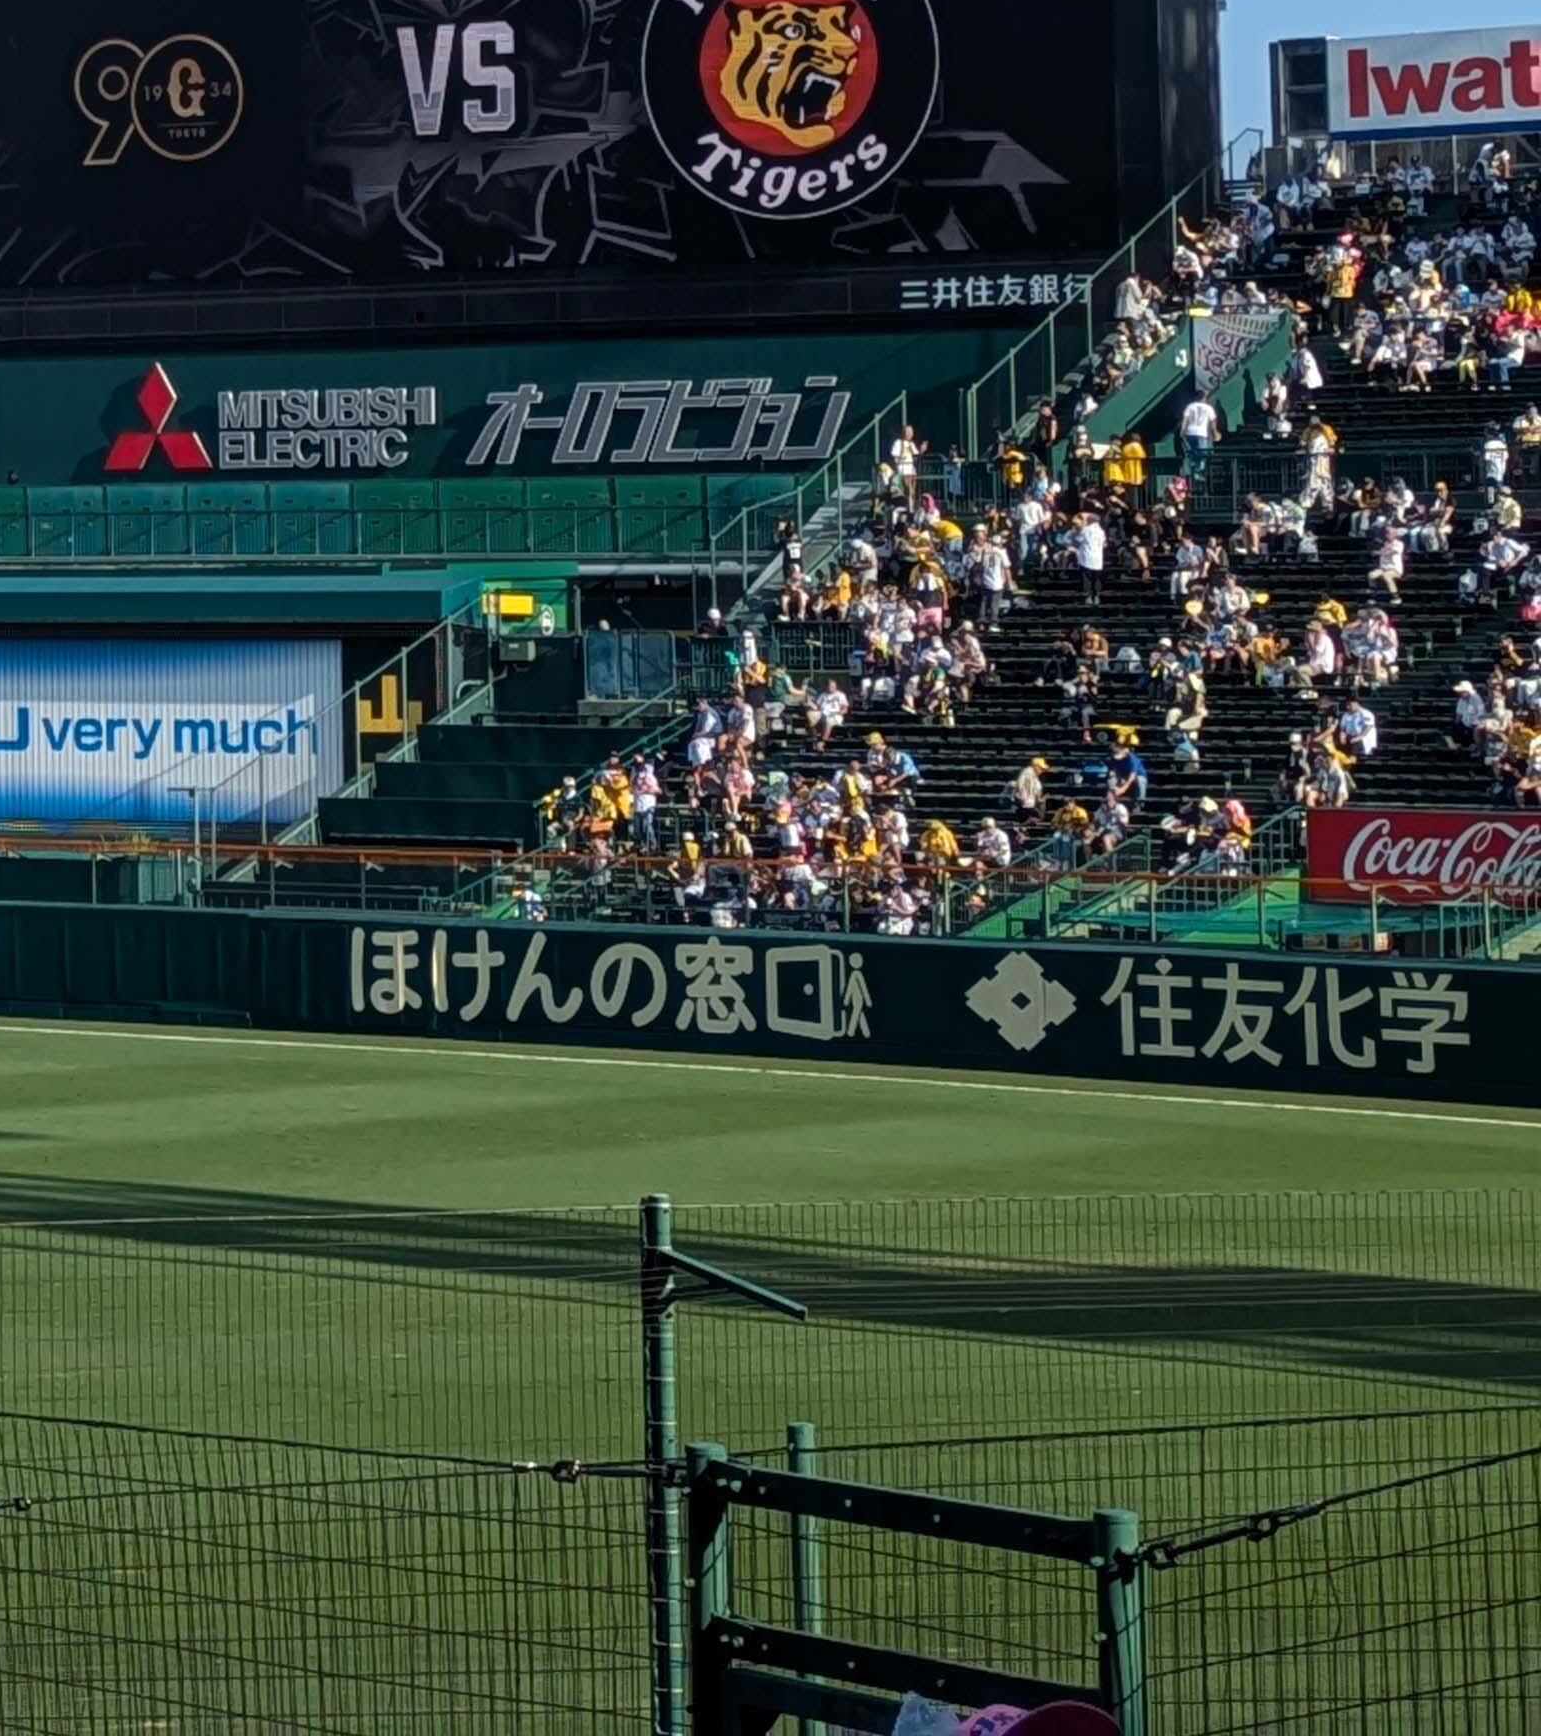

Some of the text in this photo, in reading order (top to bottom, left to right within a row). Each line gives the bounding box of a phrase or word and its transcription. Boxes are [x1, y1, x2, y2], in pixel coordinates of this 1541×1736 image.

[396, 21, 516, 137] VS
[1347, 40, 1541, 118] Iwat
[694, 131, 891, 210] Tigers
[899, 272, 1093, 310] 三井住友銀行
[218, 385, 437, 428] MITSUBISHI
[464, 375, 852, 465] オーロラビジョン
[219, 428, 410, 469] ELECTRIC
[42, 713, 163, 762] very
[174, 706, 317, 756] much
[348, 927, 847, 1041] ほけんの窓口
[1103, 955, 1473, 1073] 住友化学
